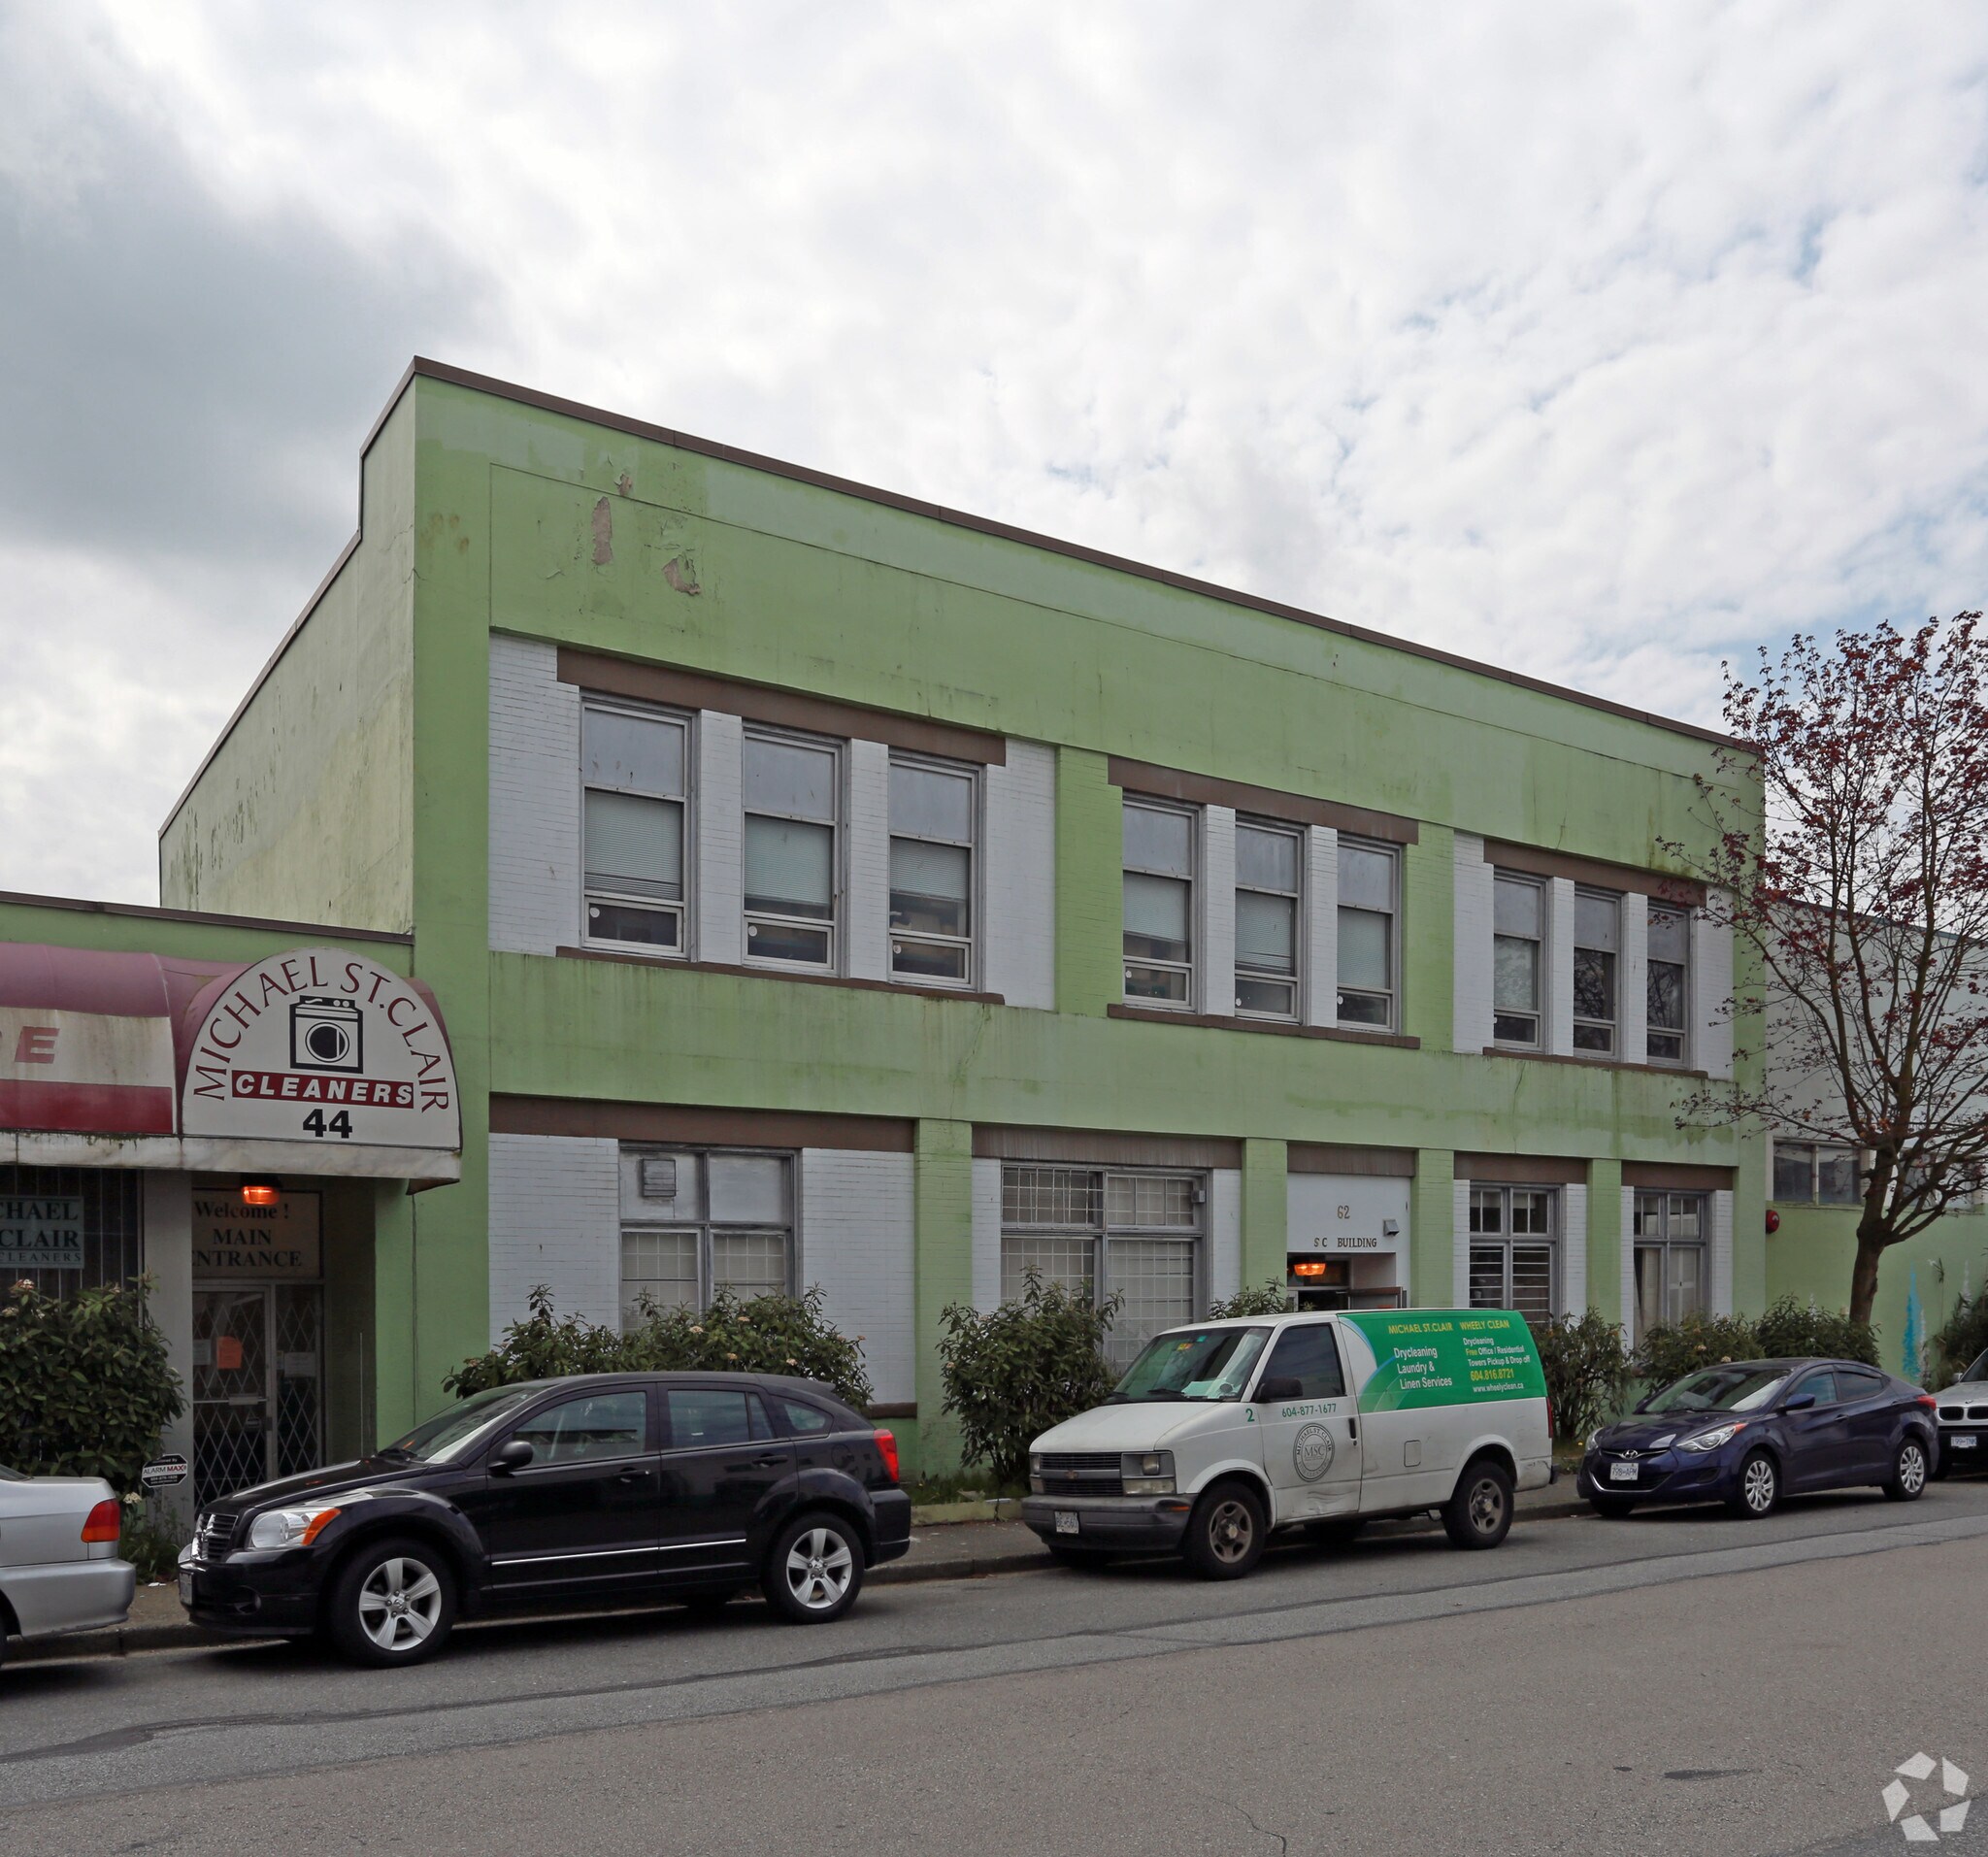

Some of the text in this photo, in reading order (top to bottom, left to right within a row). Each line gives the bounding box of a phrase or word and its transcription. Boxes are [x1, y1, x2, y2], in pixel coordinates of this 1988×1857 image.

[193, 956, 328, 1101] MICHAEL
[0, 1025, 60, 1064] E
[235, 1074, 414, 1105] CLEANERS
[302, 1108, 353, 1139] 44
[0, 1202, 78, 1220] HAEL
[194, 1202, 278, 1219] Welcome
[1337, 1205, 1350, 1219] 62
[0, 1229, 80, 1247] CLAIR
[213, 1228, 272, 1245] MAIN
[1337, 1237, 1377, 1248] BUILDING
[192, 1249, 302, 1267] NTRANCE
[1388, 1324, 1422, 1334] MICHAEL
[1459, 1319, 1510, 1331] WHEELY CLEAN
[1462, 1337, 1495, 1346] Drycleaning
[1393, 1345, 1438, 1361] Drycleaning
[1477, 1346, 1494, 1355] Office
[1497, 1344, 1525, 1354] Residential
[1396, 1360, 1435, 1375] Laundry &
[1487, 1357, 1505, 1367] Pickup
[1509, 1355, 1523, 1365] Drop
[1470, 1368, 1514, 1381] 604.816.8721
[1399, 1376, 1453, 1390] Linen Services
[1245, 1408, 1255, 1422] 2
[1281, 1403, 1337, 1417] 604-877-1677
[1304, 1445, 1325, 1457] MSC
